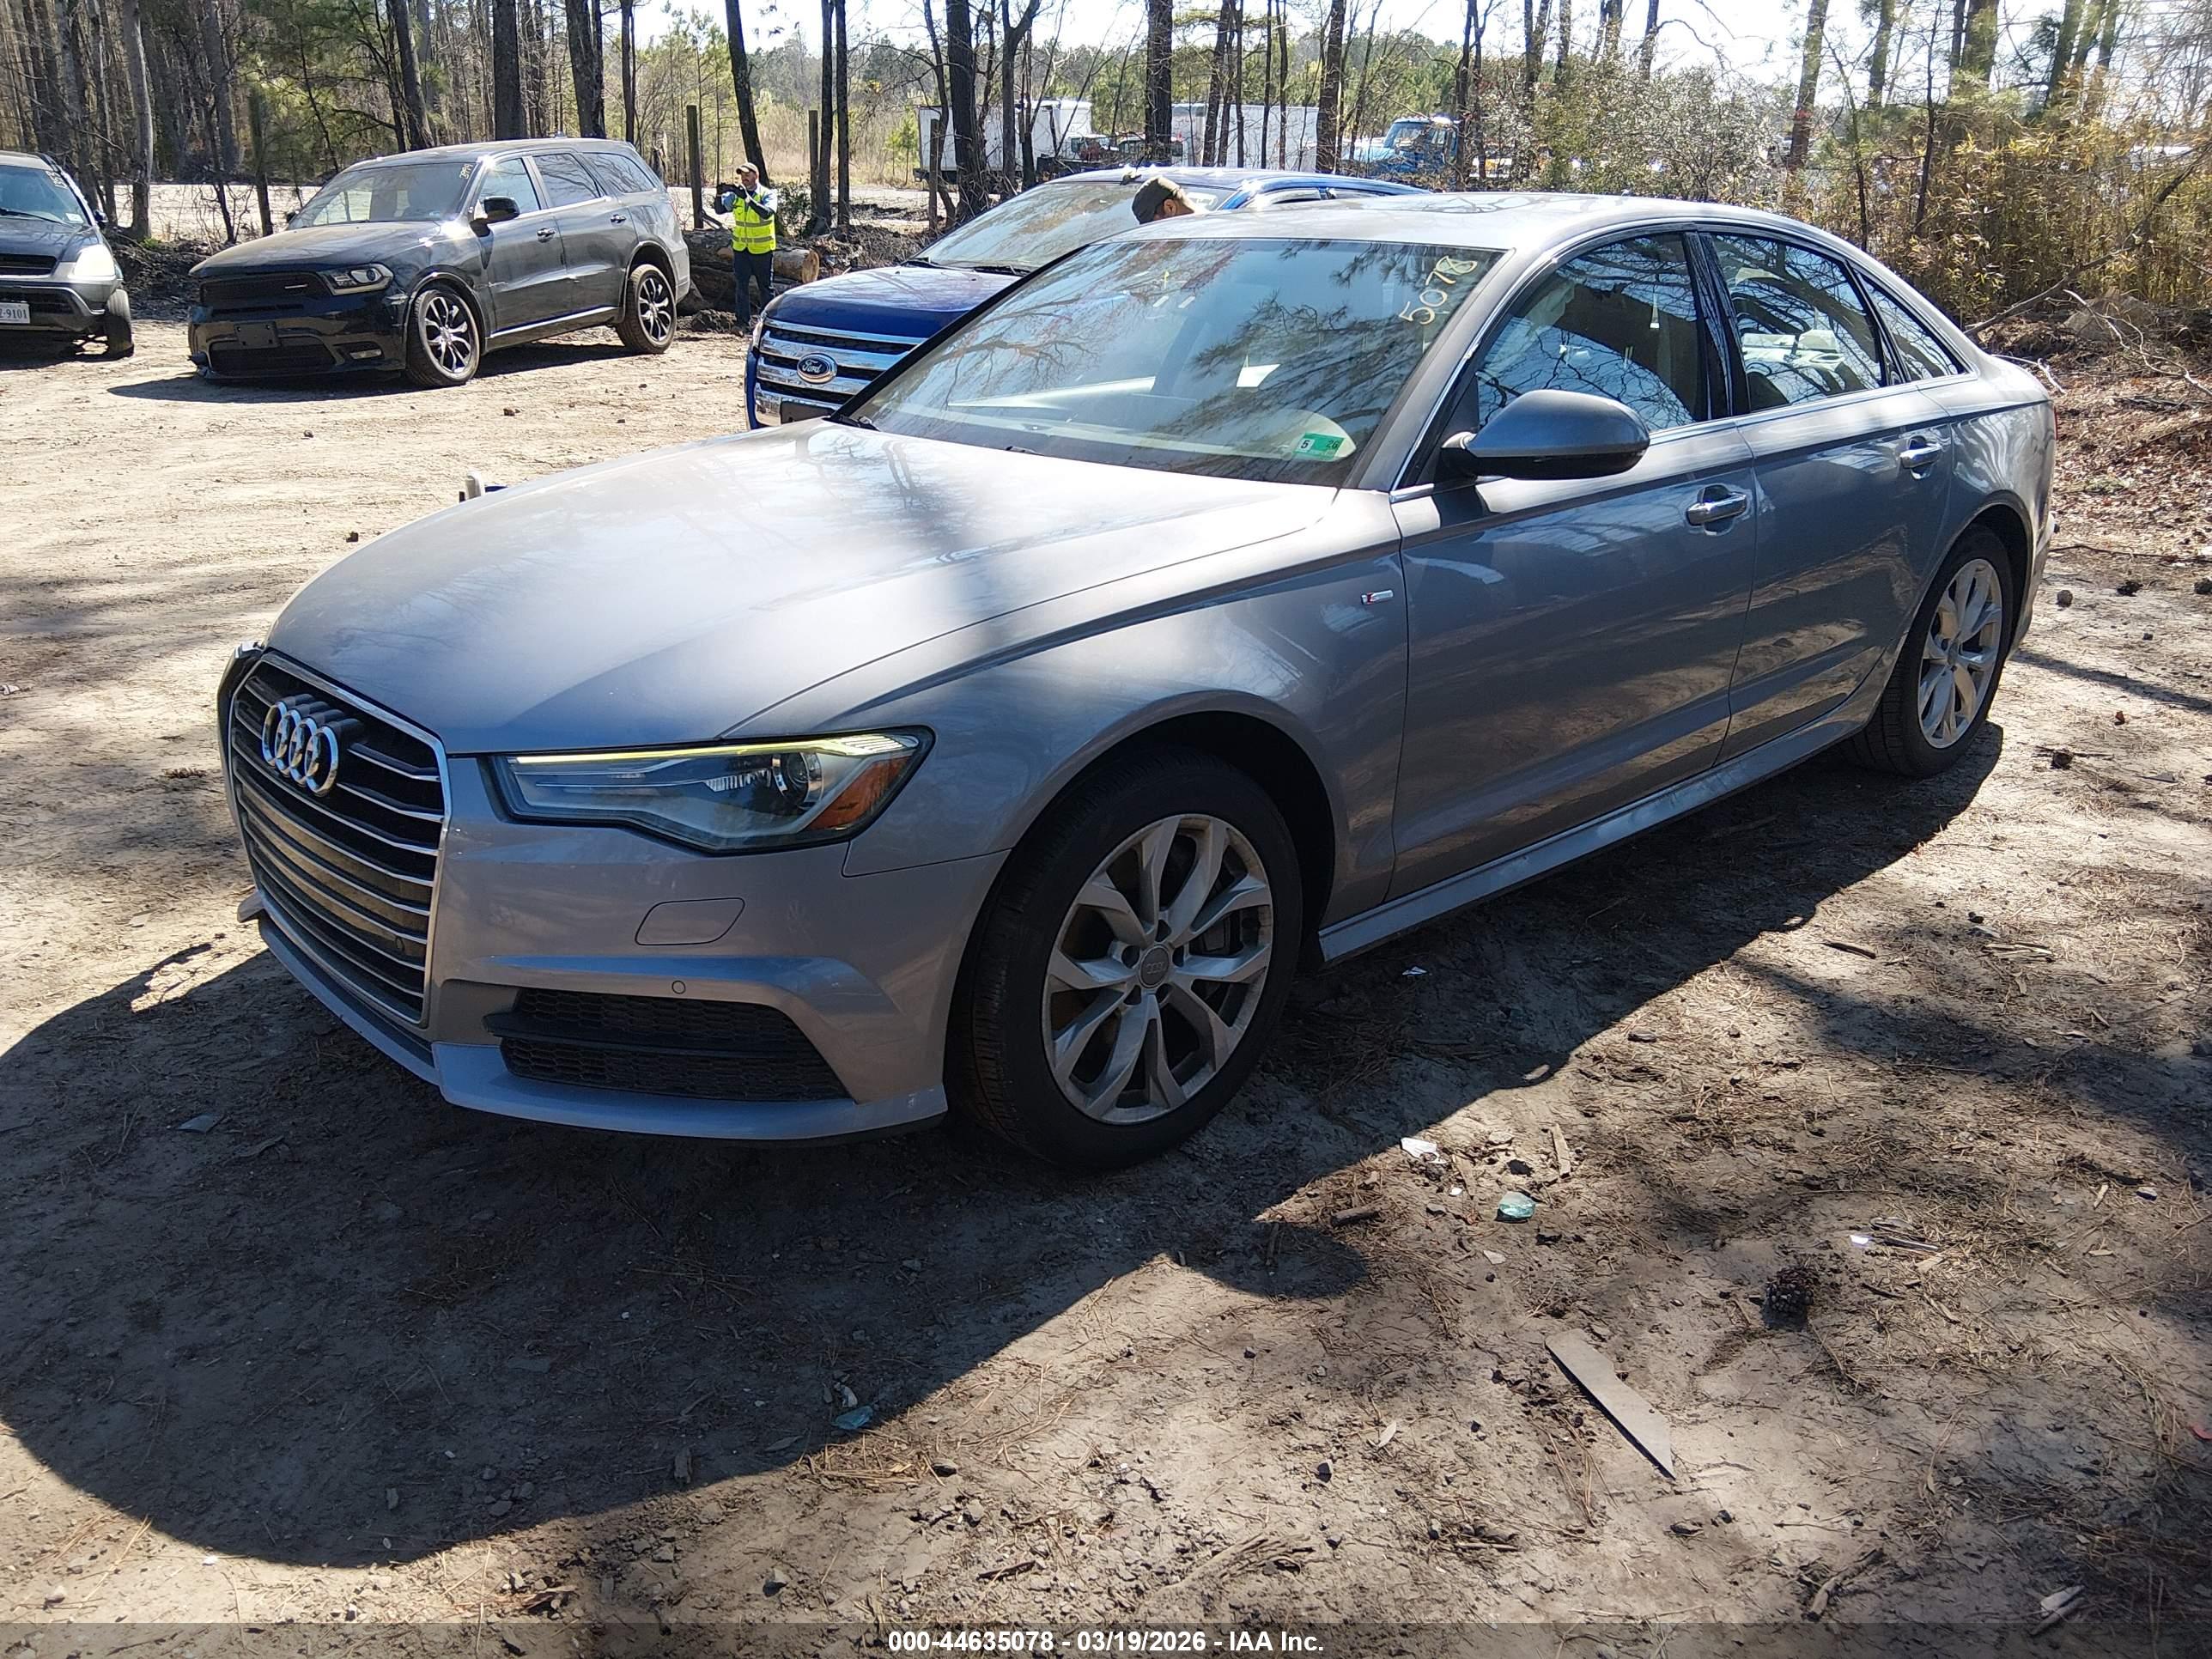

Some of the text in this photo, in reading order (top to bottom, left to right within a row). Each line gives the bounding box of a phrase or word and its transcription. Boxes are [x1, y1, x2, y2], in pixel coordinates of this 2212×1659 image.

[1398, 255, 1478, 325] 5078
[802, 359, 823, 374] Ford
[1300, 439, 1340, 450] 5 26
